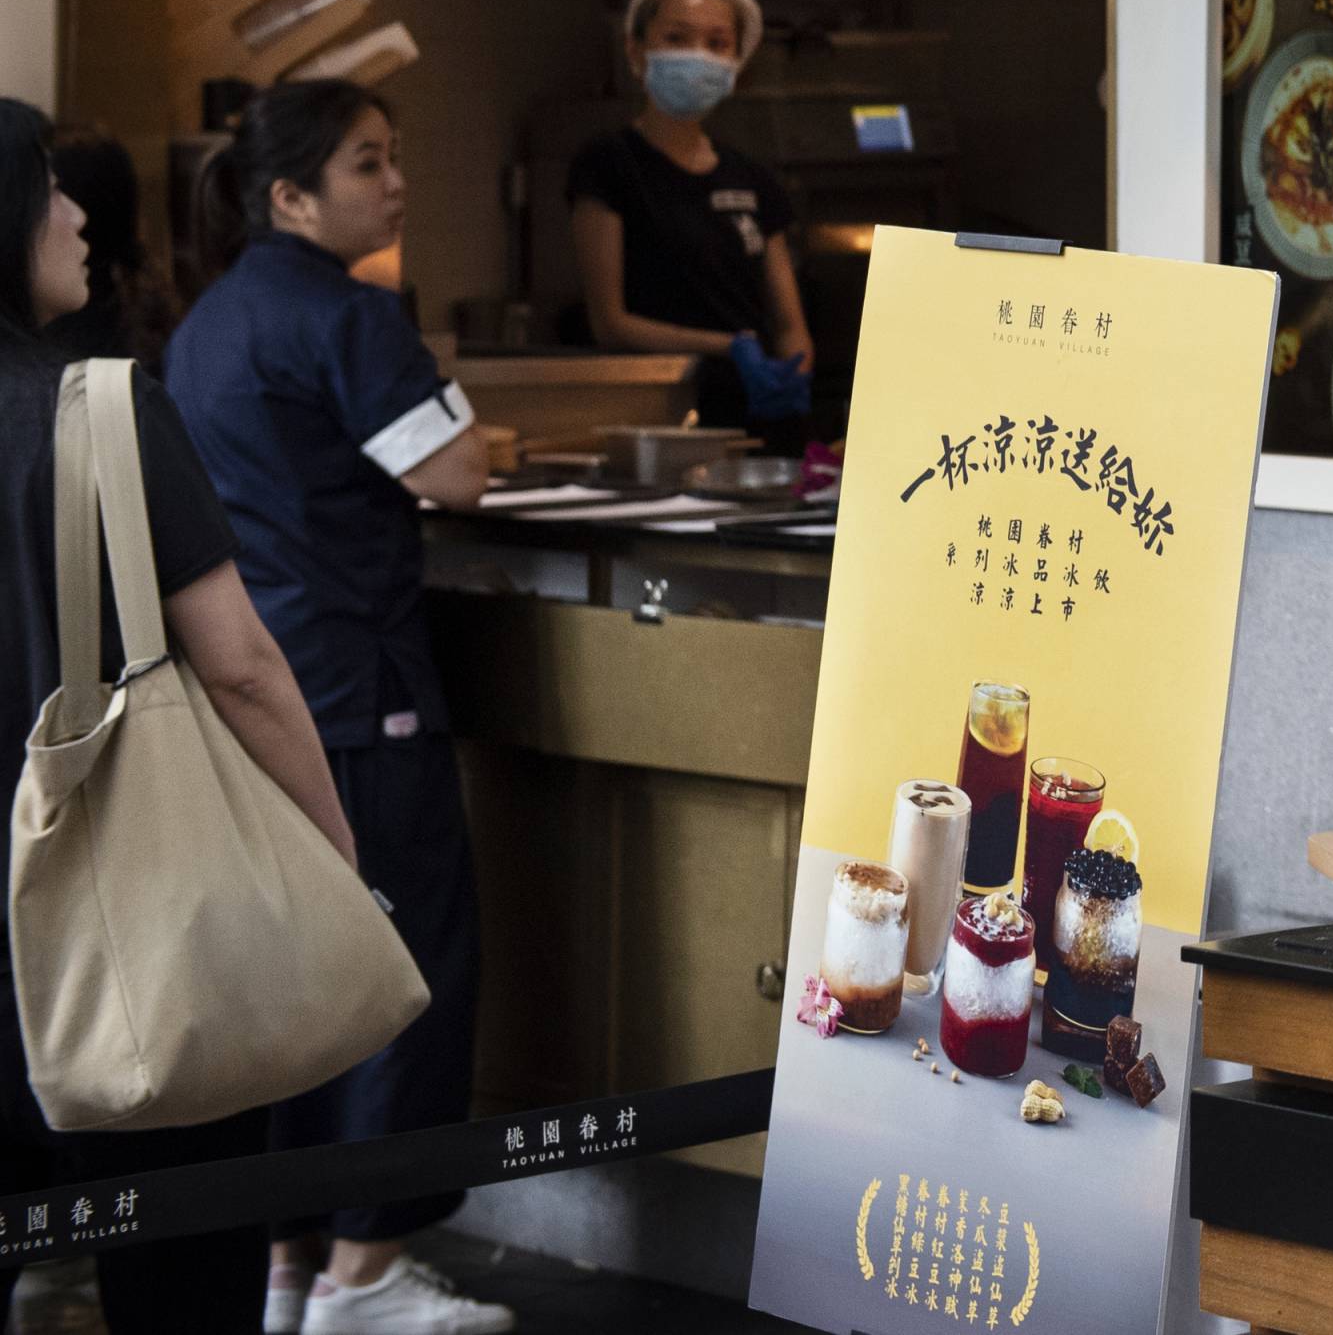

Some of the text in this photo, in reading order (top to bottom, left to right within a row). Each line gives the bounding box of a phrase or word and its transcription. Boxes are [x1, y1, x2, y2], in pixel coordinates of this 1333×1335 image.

[996, 299, 1113, 340] 桃園眷村
[992, 332, 1111, 357] TAOYUAN VILLAGE
[977, 513, 1084, 555] 桃園眷村
[945, 541, 1111, 595] 系列冰品冰飲
[969, 581, 1077, 622] 涼涼上市
[504, 1106, 638, 1152] 桃園眷村
[502, 1136, 638, 1169] TAOYUAN VILLAGE
[71, 1220, 140, 1242] VILLAGE
